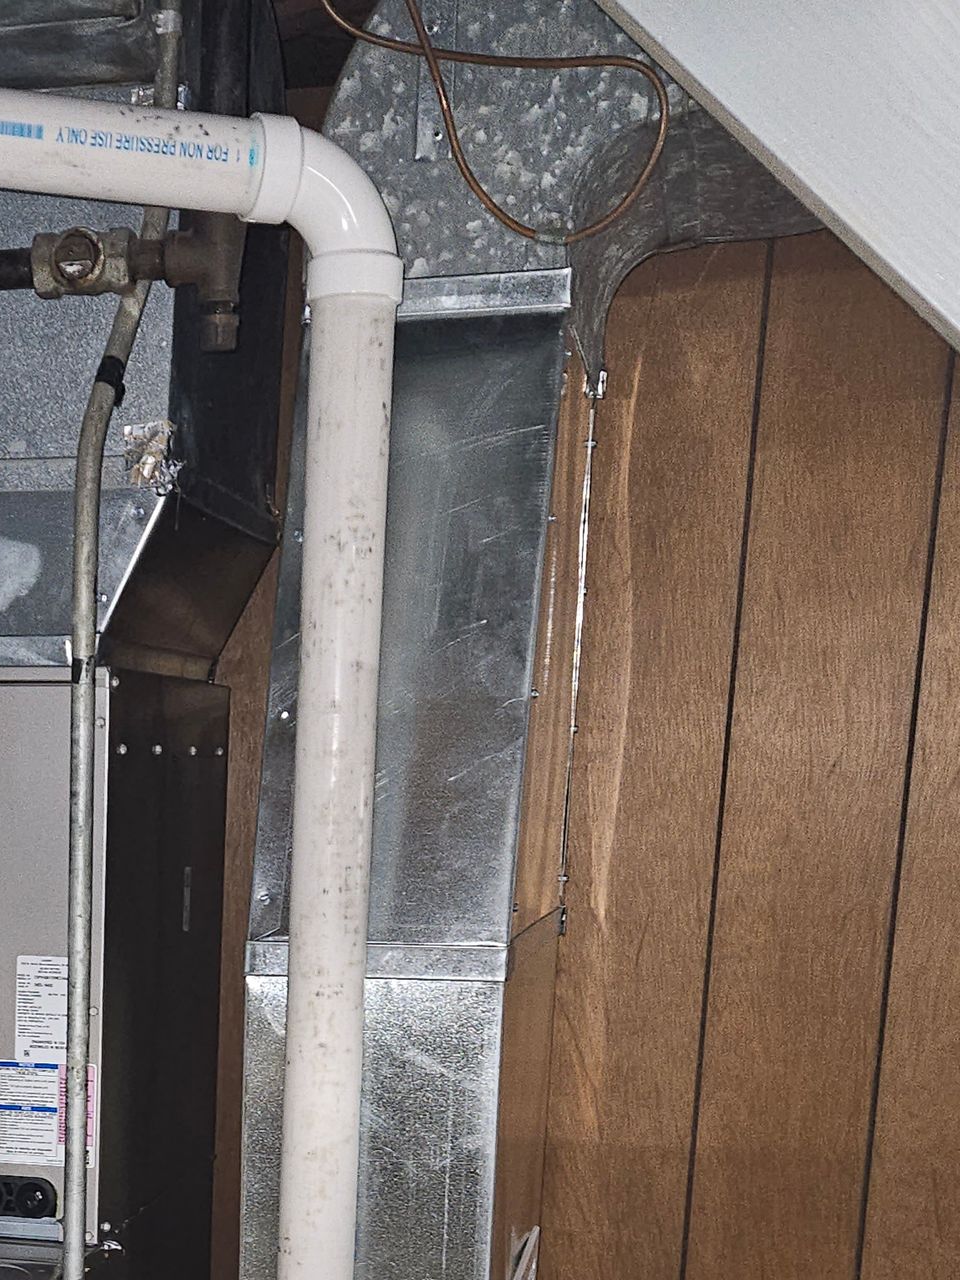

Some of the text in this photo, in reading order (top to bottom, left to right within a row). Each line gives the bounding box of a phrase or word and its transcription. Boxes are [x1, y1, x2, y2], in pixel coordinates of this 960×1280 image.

[55, 126, 88, 145] ONLY
[90, 129, 113, 149] USE
[115, 132, 177, 156] PRESSURE
[179, 139, 203, 159] NON
[206, 141, 229, 163] FOR
